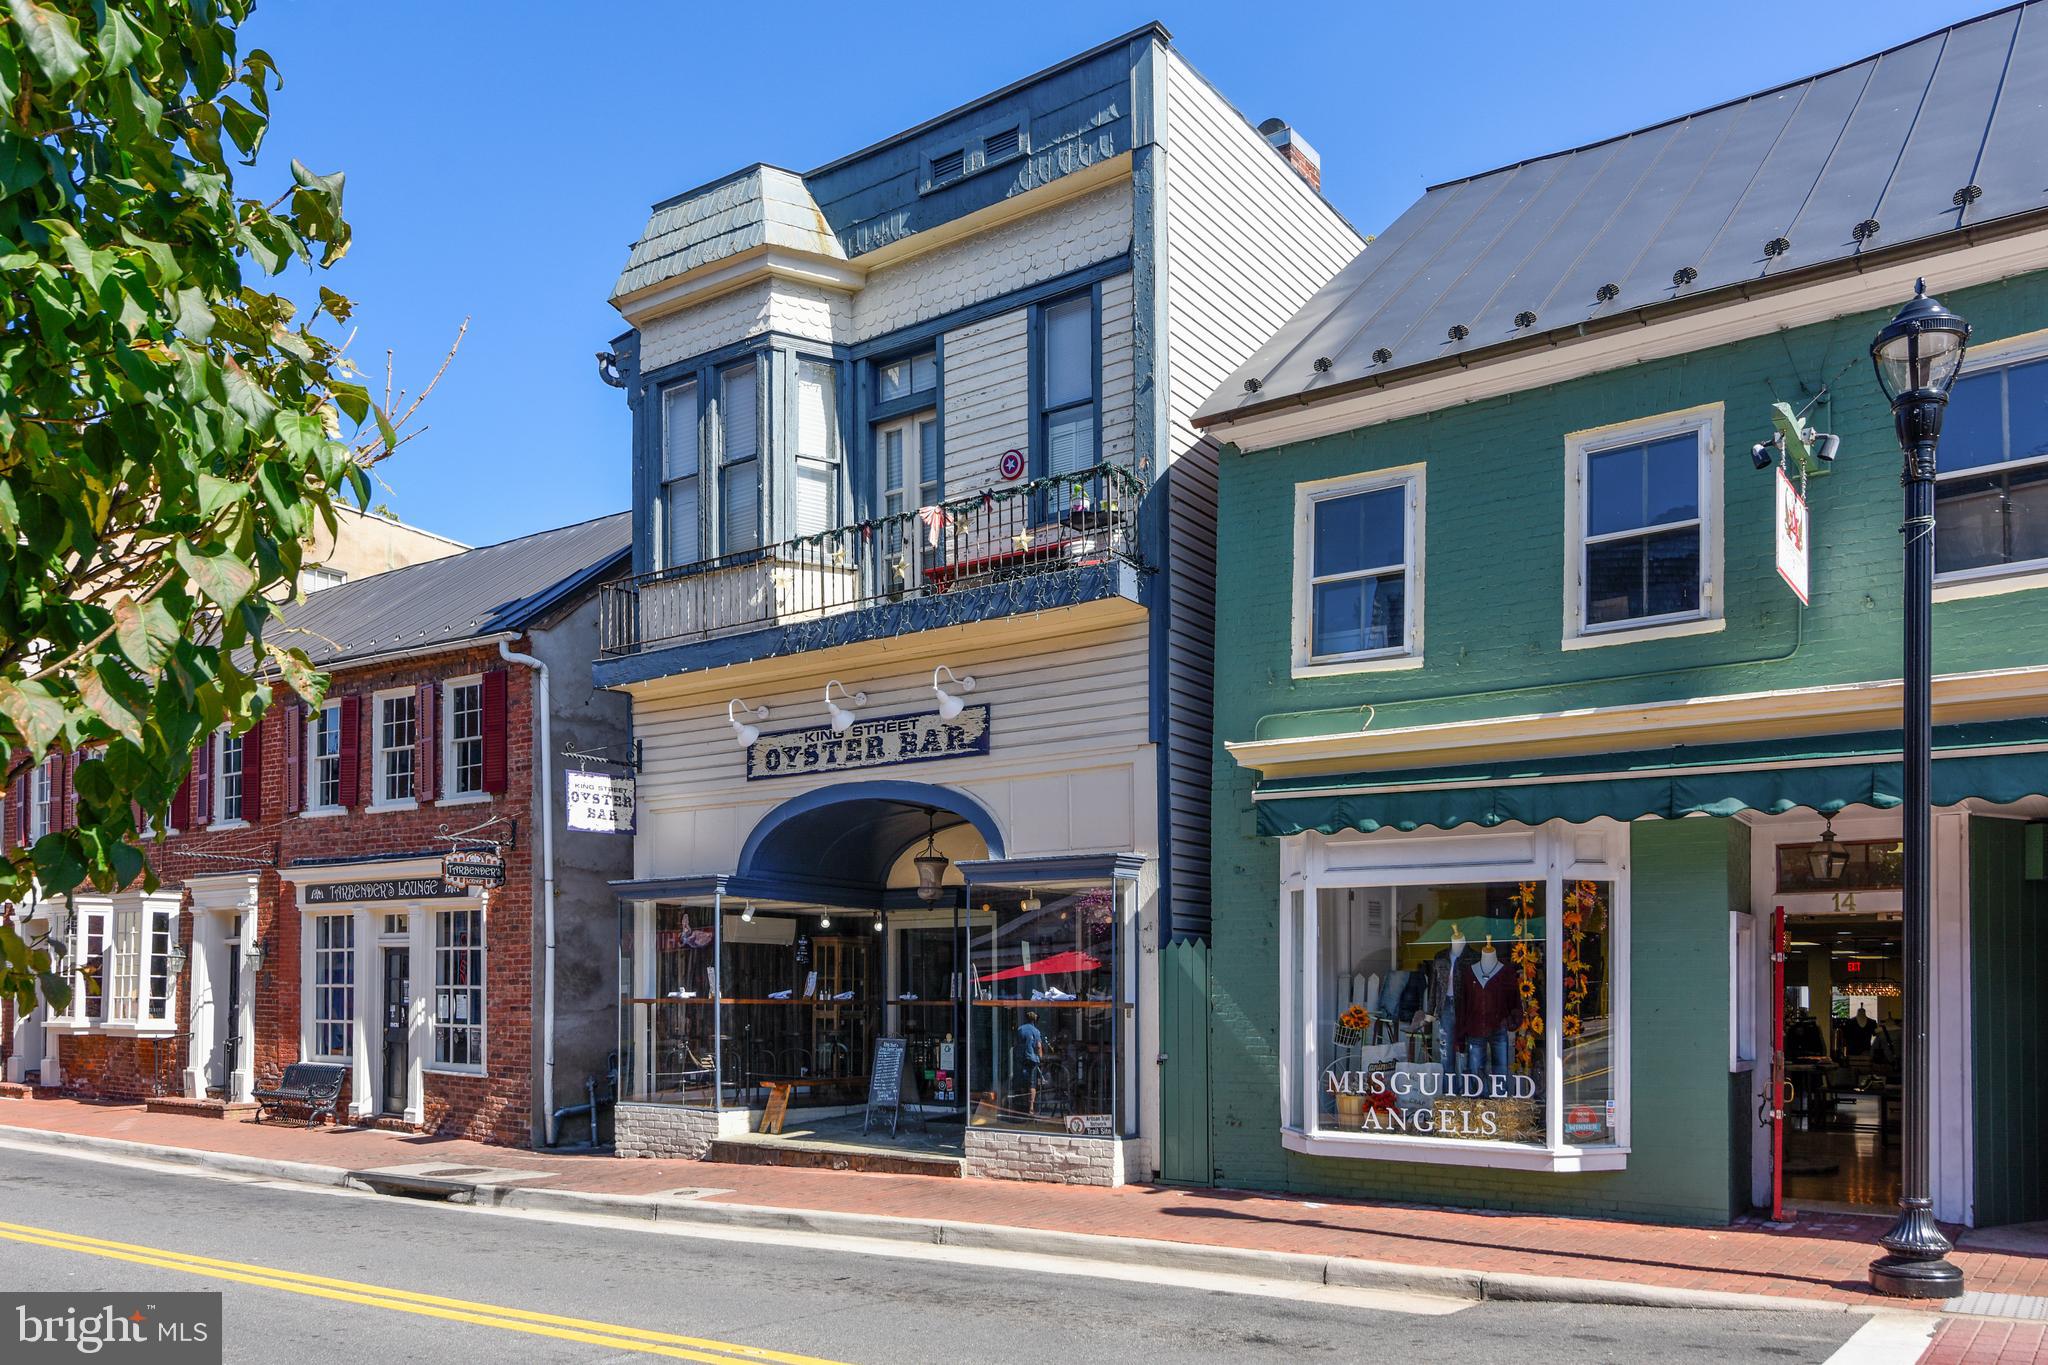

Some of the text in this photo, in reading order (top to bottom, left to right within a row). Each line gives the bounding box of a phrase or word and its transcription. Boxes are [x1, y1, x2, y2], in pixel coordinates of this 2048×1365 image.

[804, 719, 920, 743] KING STREET
[765, 723, 967, 771] OYSTER BAR
[574, 783, 628, 794] KING STREET
[571, 791, 633, 821] OYSTER BAR
[448, 864, 501, 877] TARBENDER'S
[329, 879, 439, 901] TARBENDER'S LOUNGE
[1832, 892, 1857, 912] 14
[1326, 1070, 1536, 1099] MISGUIDED
[1361, 1105, 1498, 1135] ANGELS
